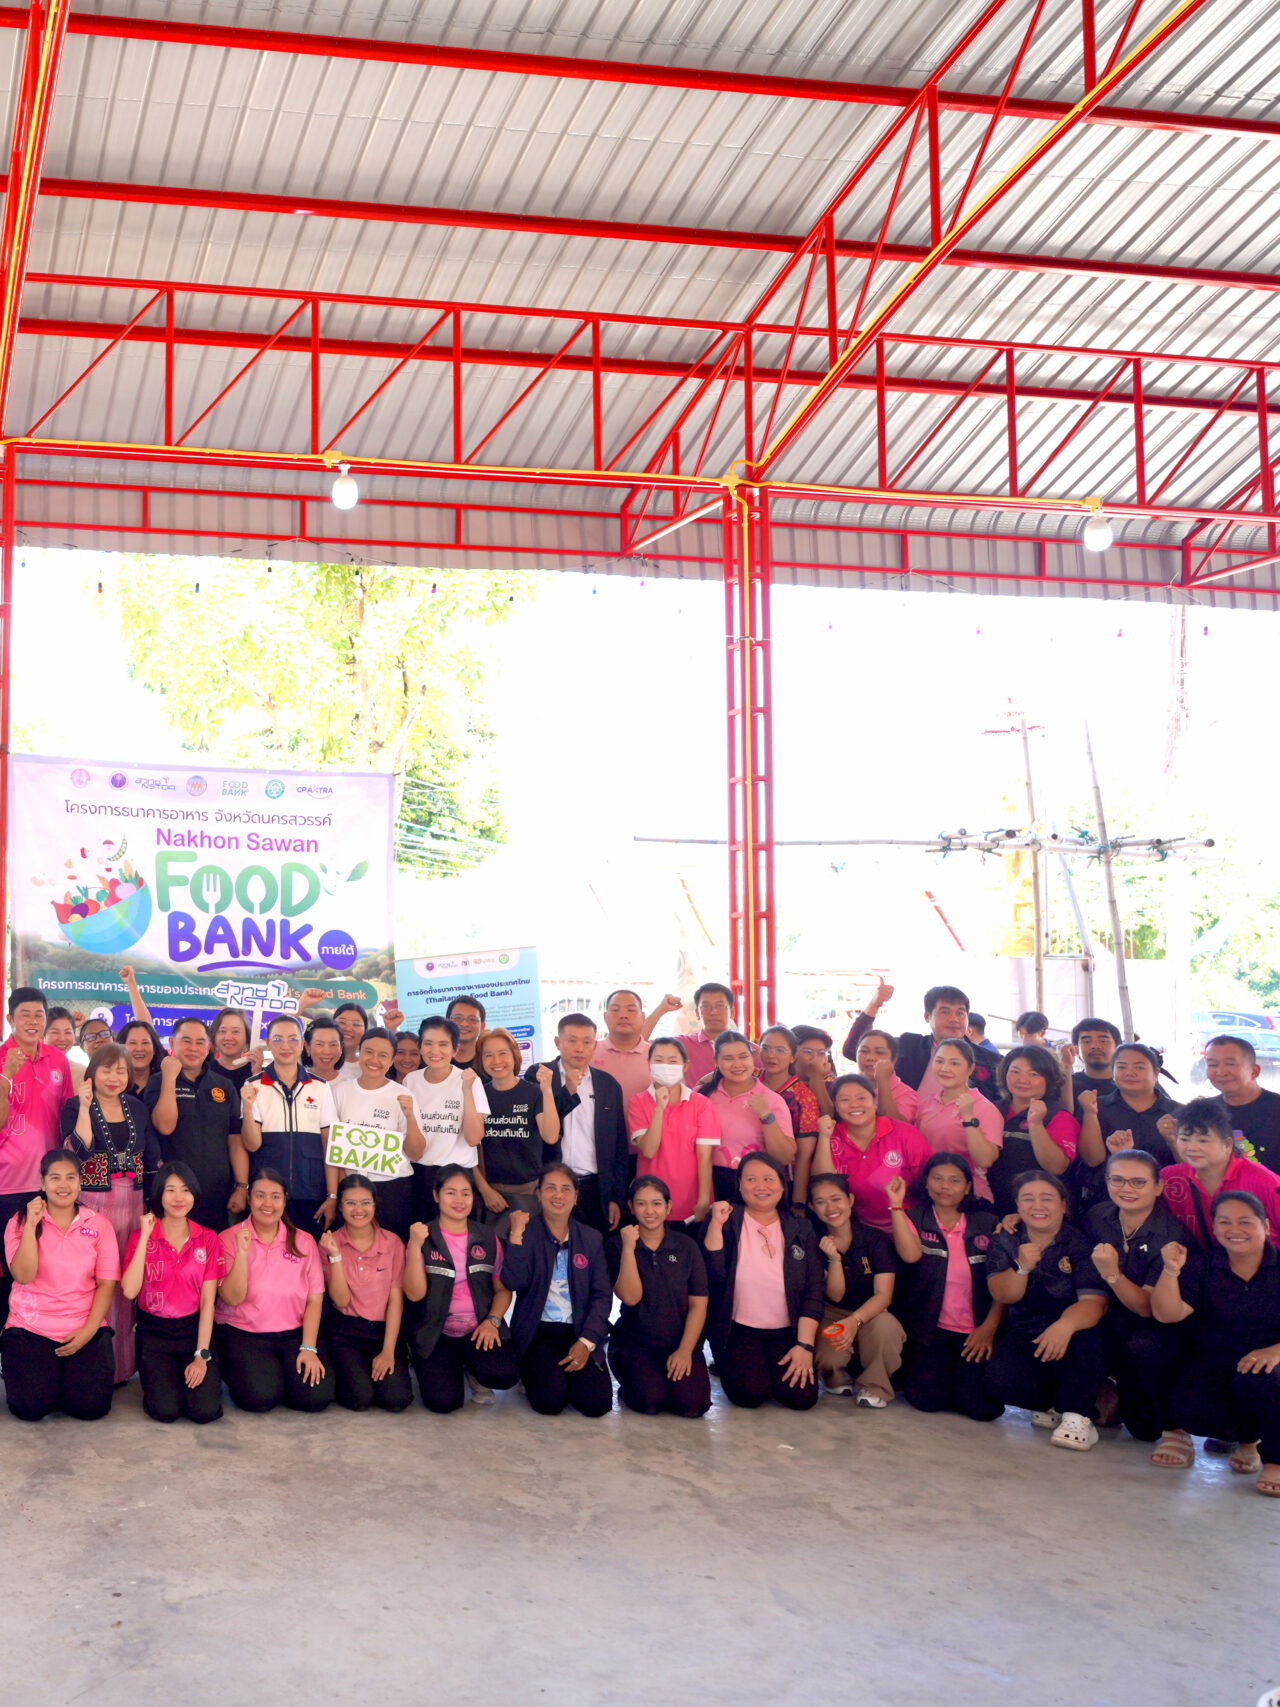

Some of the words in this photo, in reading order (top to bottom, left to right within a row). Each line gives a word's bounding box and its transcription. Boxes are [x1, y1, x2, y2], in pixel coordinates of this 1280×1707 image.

[141, 783, 176, 791] NSTDA
[222, 780, 249, 789] FOOD
[64, 800, 209, 822] โครงการธนาคารอาหาร
[214, 808, 333, 827] จังหวัดนครสวรรค์
[156, 828, 239, 850] Nakhon
[246, 832, 319, 853] Sawan
[155, 850, 321, 917] FOOD
[167, 911, 313, 962] BANK
[320, 943, 355, 956] ภายใต้
[229, 995, 298, 1010] NSTDA
[337, 989, 367, 1000] Bank
[490, 989, 513, 997] Bank)
[331, 1123, 401, 1152] FOOD
[328, 1145, 397, 1174] BANK
